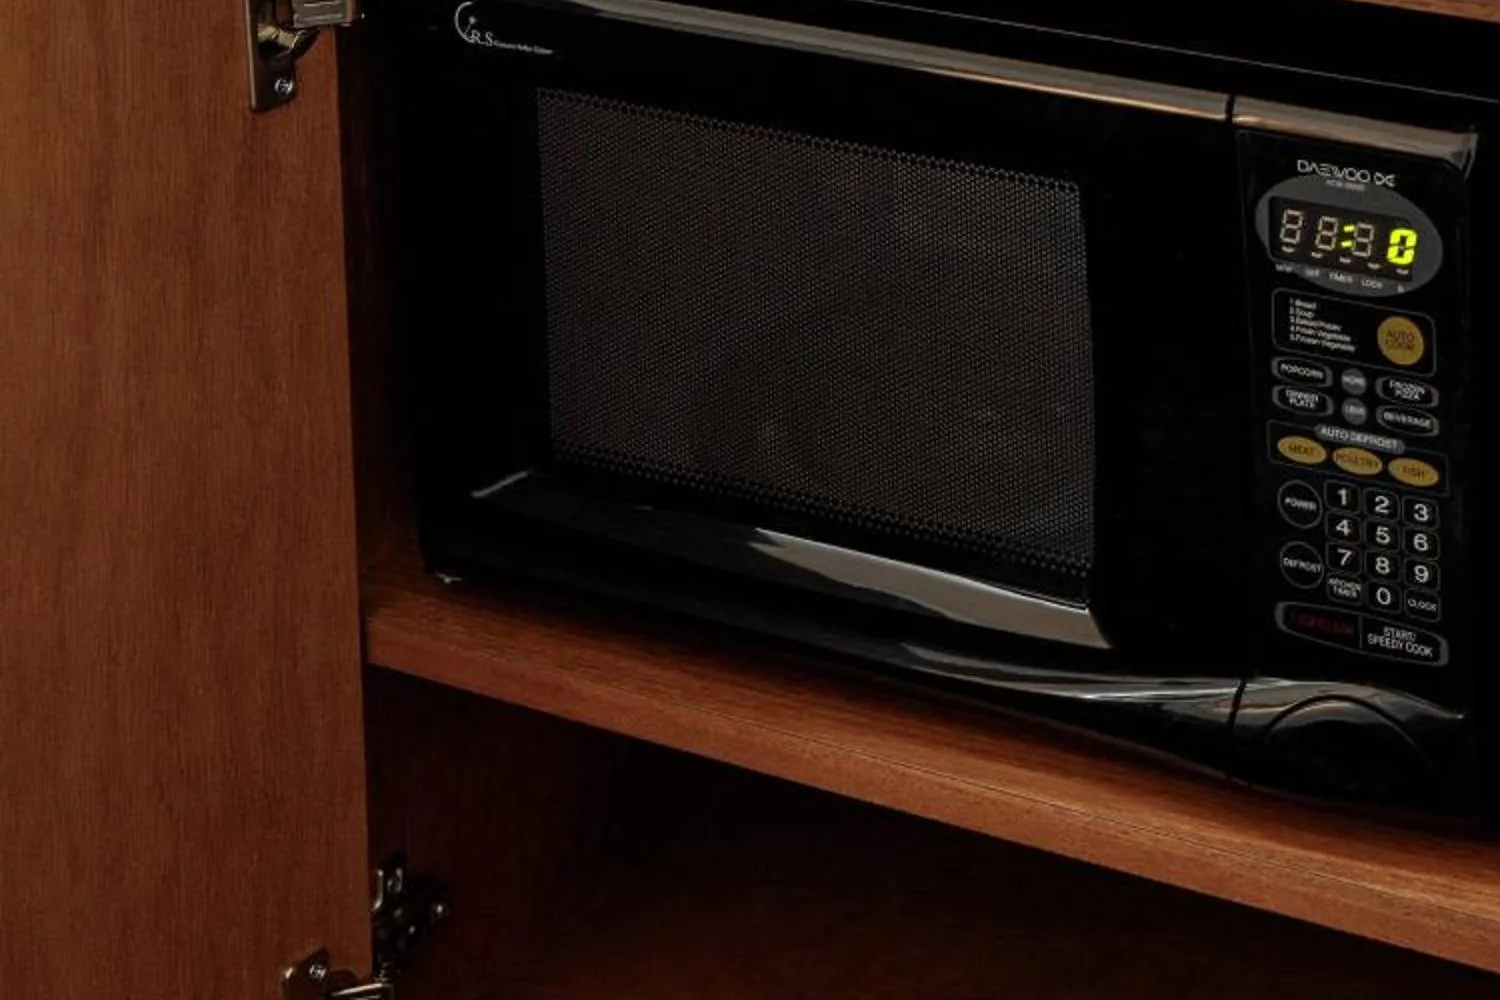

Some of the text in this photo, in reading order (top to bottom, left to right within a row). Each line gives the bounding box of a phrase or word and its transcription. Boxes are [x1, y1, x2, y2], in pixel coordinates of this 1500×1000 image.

[1296, 159, 1371, 183] DAEWOO
[1279, 362, 1325, 380] POPCORN
[1388, 379, 1426, 395] FROZEN
[1320, 426, 1398, 449] AUTO DEFROST
[1284, 496, 1317, 512] POWER
[1336, 487, 1430, 522] 1 2 3
[1335, 518, 1429, 552] 4 5 6
[1283, 557, 1321, 573] DEFROST
[1336, 548, 1430, 584] 7 8 9
[1376, 586, 1391, 606] 0
[1407, 597, 1437, 612] CLOCK
[1367, 632, 1434, 658] SPEEDY COOK
